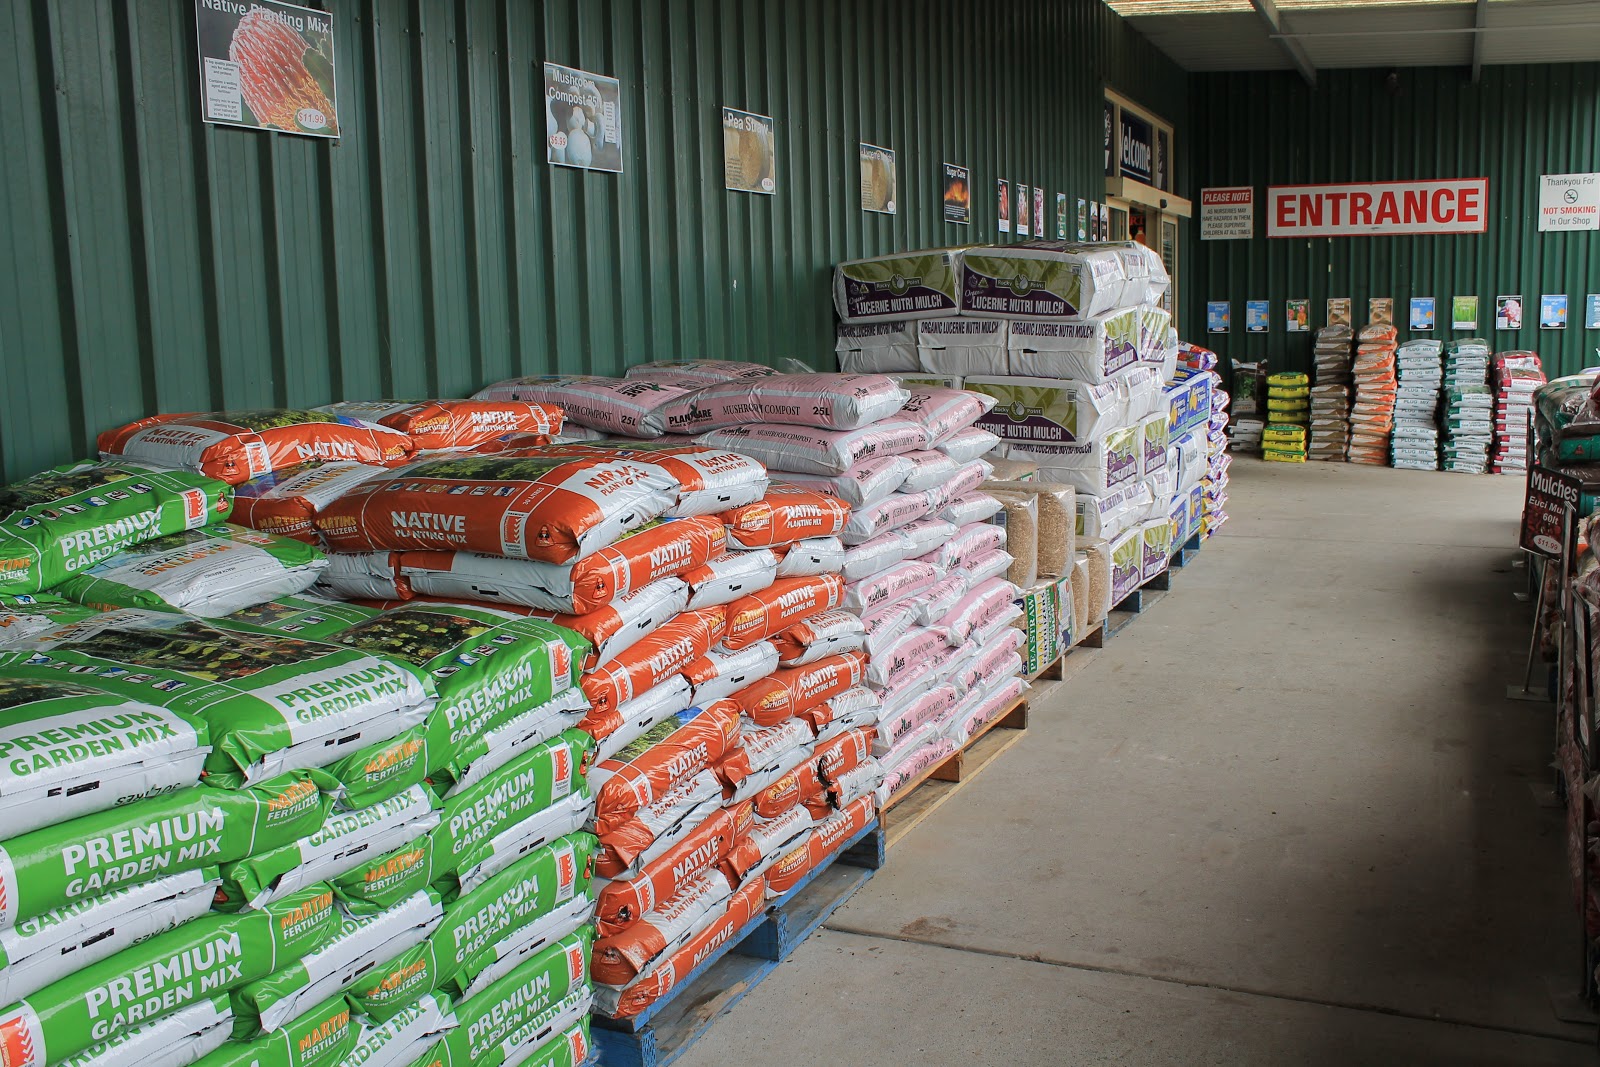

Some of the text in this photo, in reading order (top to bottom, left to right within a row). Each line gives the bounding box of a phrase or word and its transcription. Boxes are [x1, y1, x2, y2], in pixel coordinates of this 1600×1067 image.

[250, 3, 304, 31] Planting
[307, 16, 329, 34] Mix
[552, 69, 595, 88] Mushroom
[548, 86, 587, 107] Compost
[297, 111, 324, 124] $11.99
[727, 112, 769, 136] Pea Straw
[946, 165, 966, 179] Sugar Cane
[1547, 176, 1595, 187] Thankyou For
[1204, 192, 1250, 202] PLEASE NOTE
[1276, 188, 1480, 228] ENTRANCE
[1543, 206, 1597, 215] NOT SMOKING
[1557, 217, 1571, 225] Our
[1572, 216, 1591, 226] Shop
[998, 279, 1045, 289] Rocky Point
[856, 295, 943, 315] LUCERNE NUTRI MULCH
[972, 295, 1065, 314] LUCERNE NUTRI MULCH
[890, 321, 907, 334] MULCH
[921, 321, 1000, 334] ORGANIC LUCERNE NUTRI MULCH
[1011, 322, 1094, 339] ORGANIC LUCERNE NUTRI MULCH
[471, 411, 517, 424] NATIVE
[580, 406, 636, 426] COMPOST 25L
[764, 404, 801, 416] COMPOST
[812, 406, 830, 417] 25L
[147, 428, 211, 441] NATIVE
[472, 425, 505, 433] PLANTING
[756, 429, 786, 440] MUSHROOM
[786, 432, 813, 443] COMPOST
[1007, 425, 1062, 440] NUTRI MULCH
[139, 436, 198, 447] PLANTING MIX
[296, 442, 358, 459] NATIVE
[694, 453, 743, 468] NATIVE
[737, 461, 750, 469] MIX
[530, 487, 545, 500] LITRES
[1530, 471, 1578, 502] Mulches
[390, 510, 466, 533] NATIVE
[785, 504, 822, 519] NATIVE
[786, 518, 823, 528] PLANTING MIX
[60, 504, 163, 558] PREMIUM
[326, 526, 358, 535] TILIZERS
[395, 529, 468, 544] PLANTING MIX
[64, 537, 136, 572] GARDEN
[649, 539, 692, 569] NATIVE
[650, 556, 692, 580] PLANTING MIX
[777, 584, 815, 605] NATIVE
[780, 598, 816, 619] PLANTING MIX
[733, 616, 765, 633] FERTILIZERS
[1028, 598, 1036, 643] STRAW
[1036, 593, 1044, 667] MARTINS
[650, 637, 695, 677] NATIVE
[682, 654, 695, 667] MIX
[273, 663, 397, 709] PREMIUM
[799, 664, 838, 690] NATIVE
[185, 688, 226, 707] 30 LITRES
[295, 677, 409, 725] GARDEN MIX
[445, 661, 532, 729] PREMIUM
[508, 684, 533, 708] MIX
[805, 683, 832, 700] PLANTING
[0, 711, 165, 759] PREMIUM
[751, 734, 784, 757] PLANTING
[9, 723, 180, 777] GARDEN MIX
[667, 741, 708, 780] NATIVE
[449, 767, 535, 839] PREMIUM
[509, 789, 535, 812] MIX
[308, 789, 418, 847] GARDEN MIX
[763, 816, 789, 839] PLANTING
[788, 810, 800, 824] MIX
[815, 808, 853, 840] NATIVE
[62, 806, 225, 876] PREMIUM
[65, 835, 222, 898] GARDEN MIX
[672, 834, 720, 881] NATIVE
[363, 858, 425, 894] FERTILIZERS
[452, 875, 539, 948] PREMIUM
[512, 896, 538, 924] MIX
[665, 891, 700, 922] PLANTING
[699, 879, 714, 897] MIX
[691, 920, 735, 969] NATIVE
[85, 932, 243, 1019] PREMIUM
[364, 969, 428, 1004] FERTILIZERS
[91, 986, 194, 1041] GARDEN
[200, 961, 244, 991] MIX
[467, 970, 551, 1047] PREMIUM
[393, 999, 428, 1032] MIX
[509, 1004, 562, 1047] GARDEN
[299, 1009, 350, 1052] MARTIN
[469, 994, 551, 1061] GARDEN MIX
